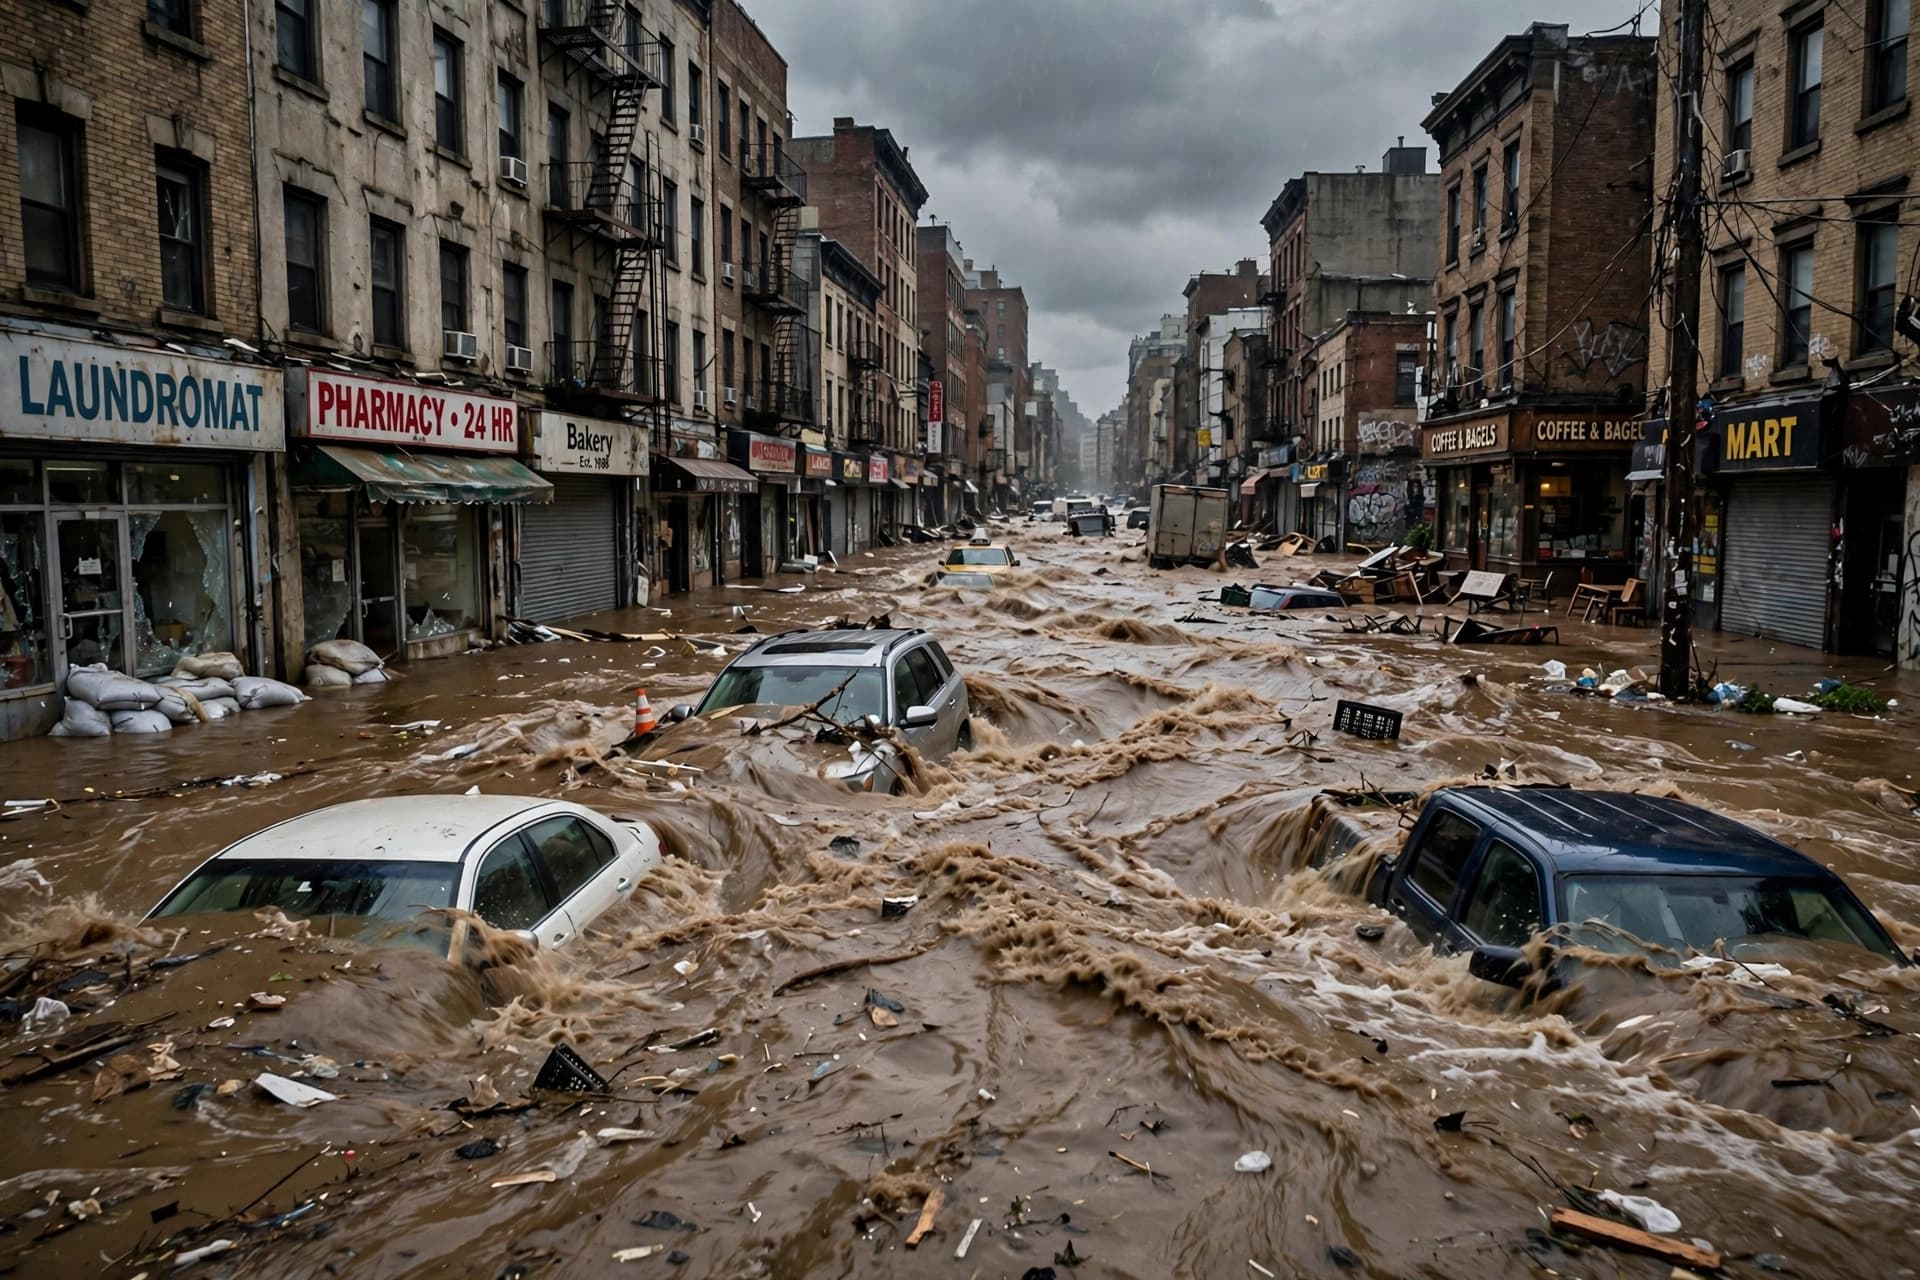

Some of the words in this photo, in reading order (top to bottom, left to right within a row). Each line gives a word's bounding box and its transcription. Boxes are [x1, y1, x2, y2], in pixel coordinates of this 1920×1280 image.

[19, 355, 263, 432] LAUNDROMAT
[318, 381, 445, 436] PHARMACY
[464, 402, 486, 440] 24
[491, 406, 514, 442] HR
[566, 422, 613, 457] Bakery
[1431, 430, 1457, 453] COFFEE
[1465, 423, 1496, 449] BAGELS
[1537, 420, 1586, 441] COFFEE
[1590, 421, 1600, 440] &
[1604, 420, 1646, 440] BAGEL
[1726, 416, 1797, 461] MART
